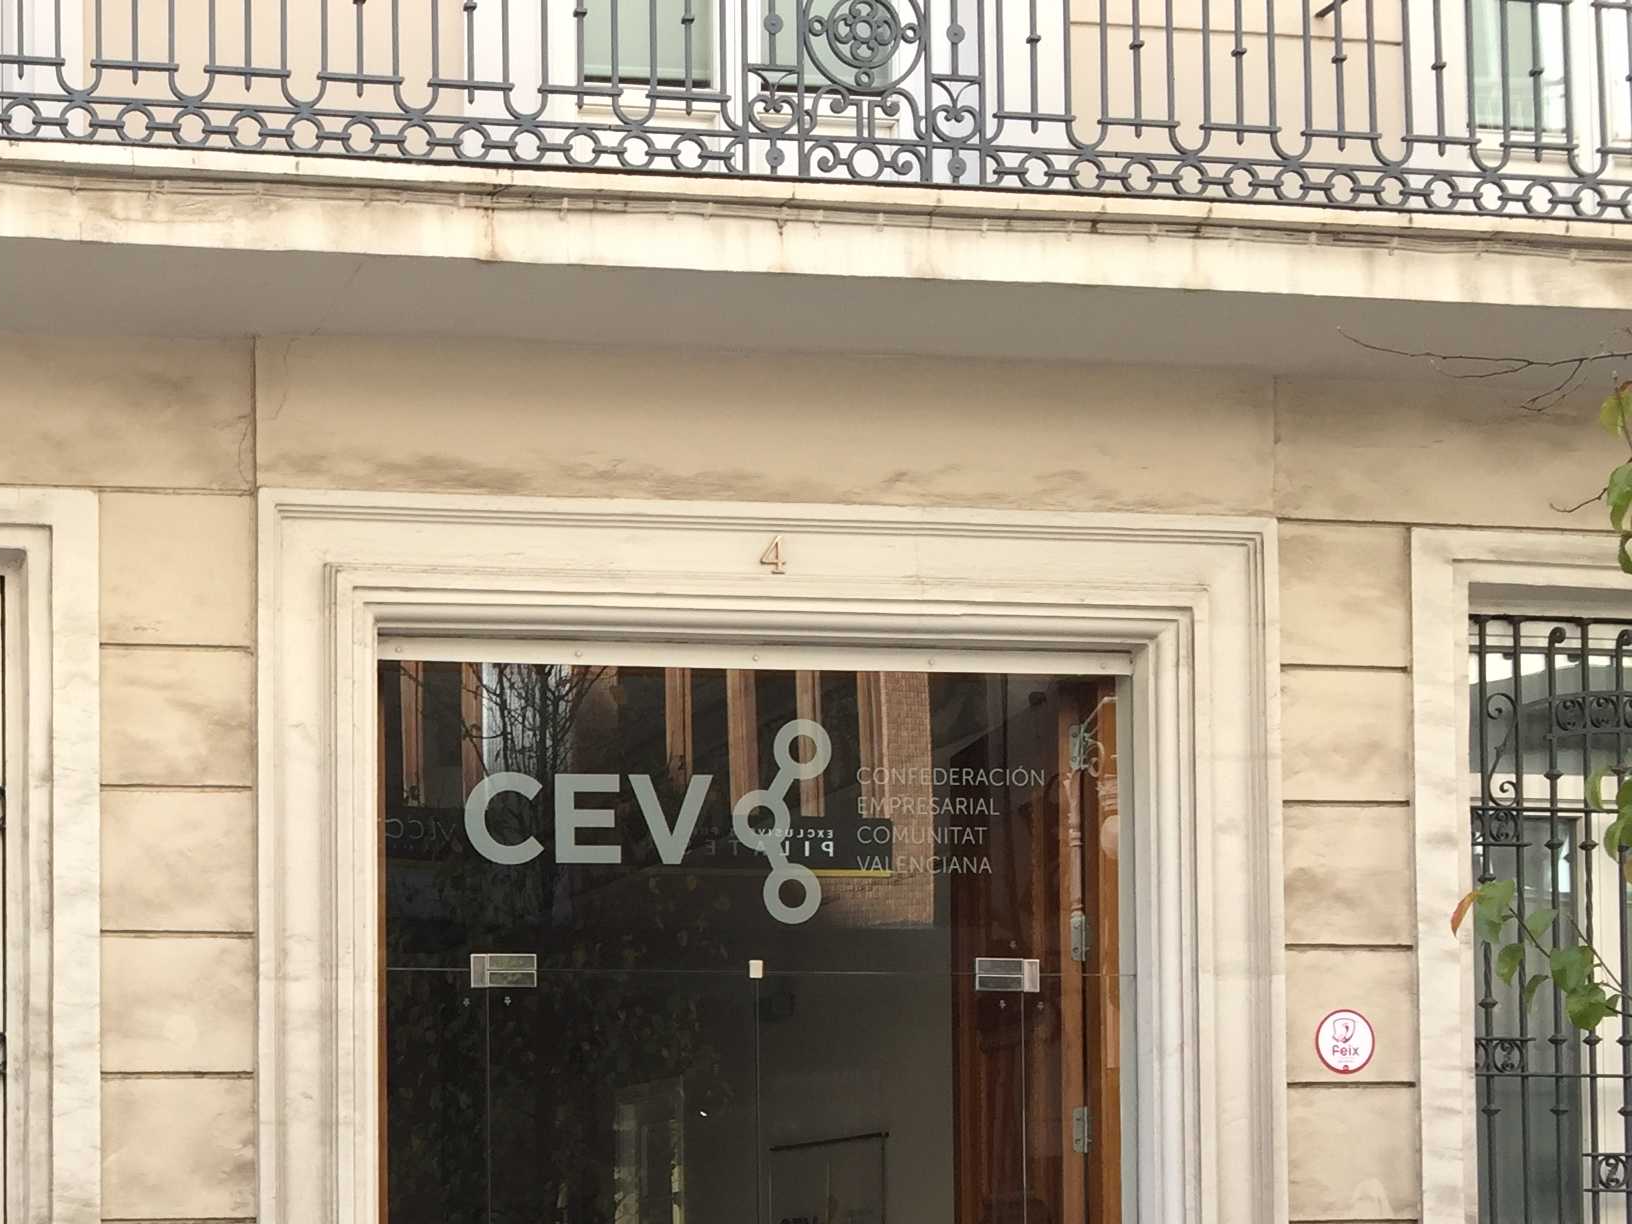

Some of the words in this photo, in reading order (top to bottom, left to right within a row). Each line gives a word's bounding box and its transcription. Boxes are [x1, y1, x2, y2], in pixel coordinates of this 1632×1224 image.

[759, 535, 786, 575] 4
[856, 765, 1045, 786] CONFEDERACIÓN
[856, 796, 1001, 815] EMPRESARIAL
[464, 771, 714, 865] CEV
[856, 825, 988, 844] COMUNITAT
[856, 855, 993, 875] VALENCIANA
